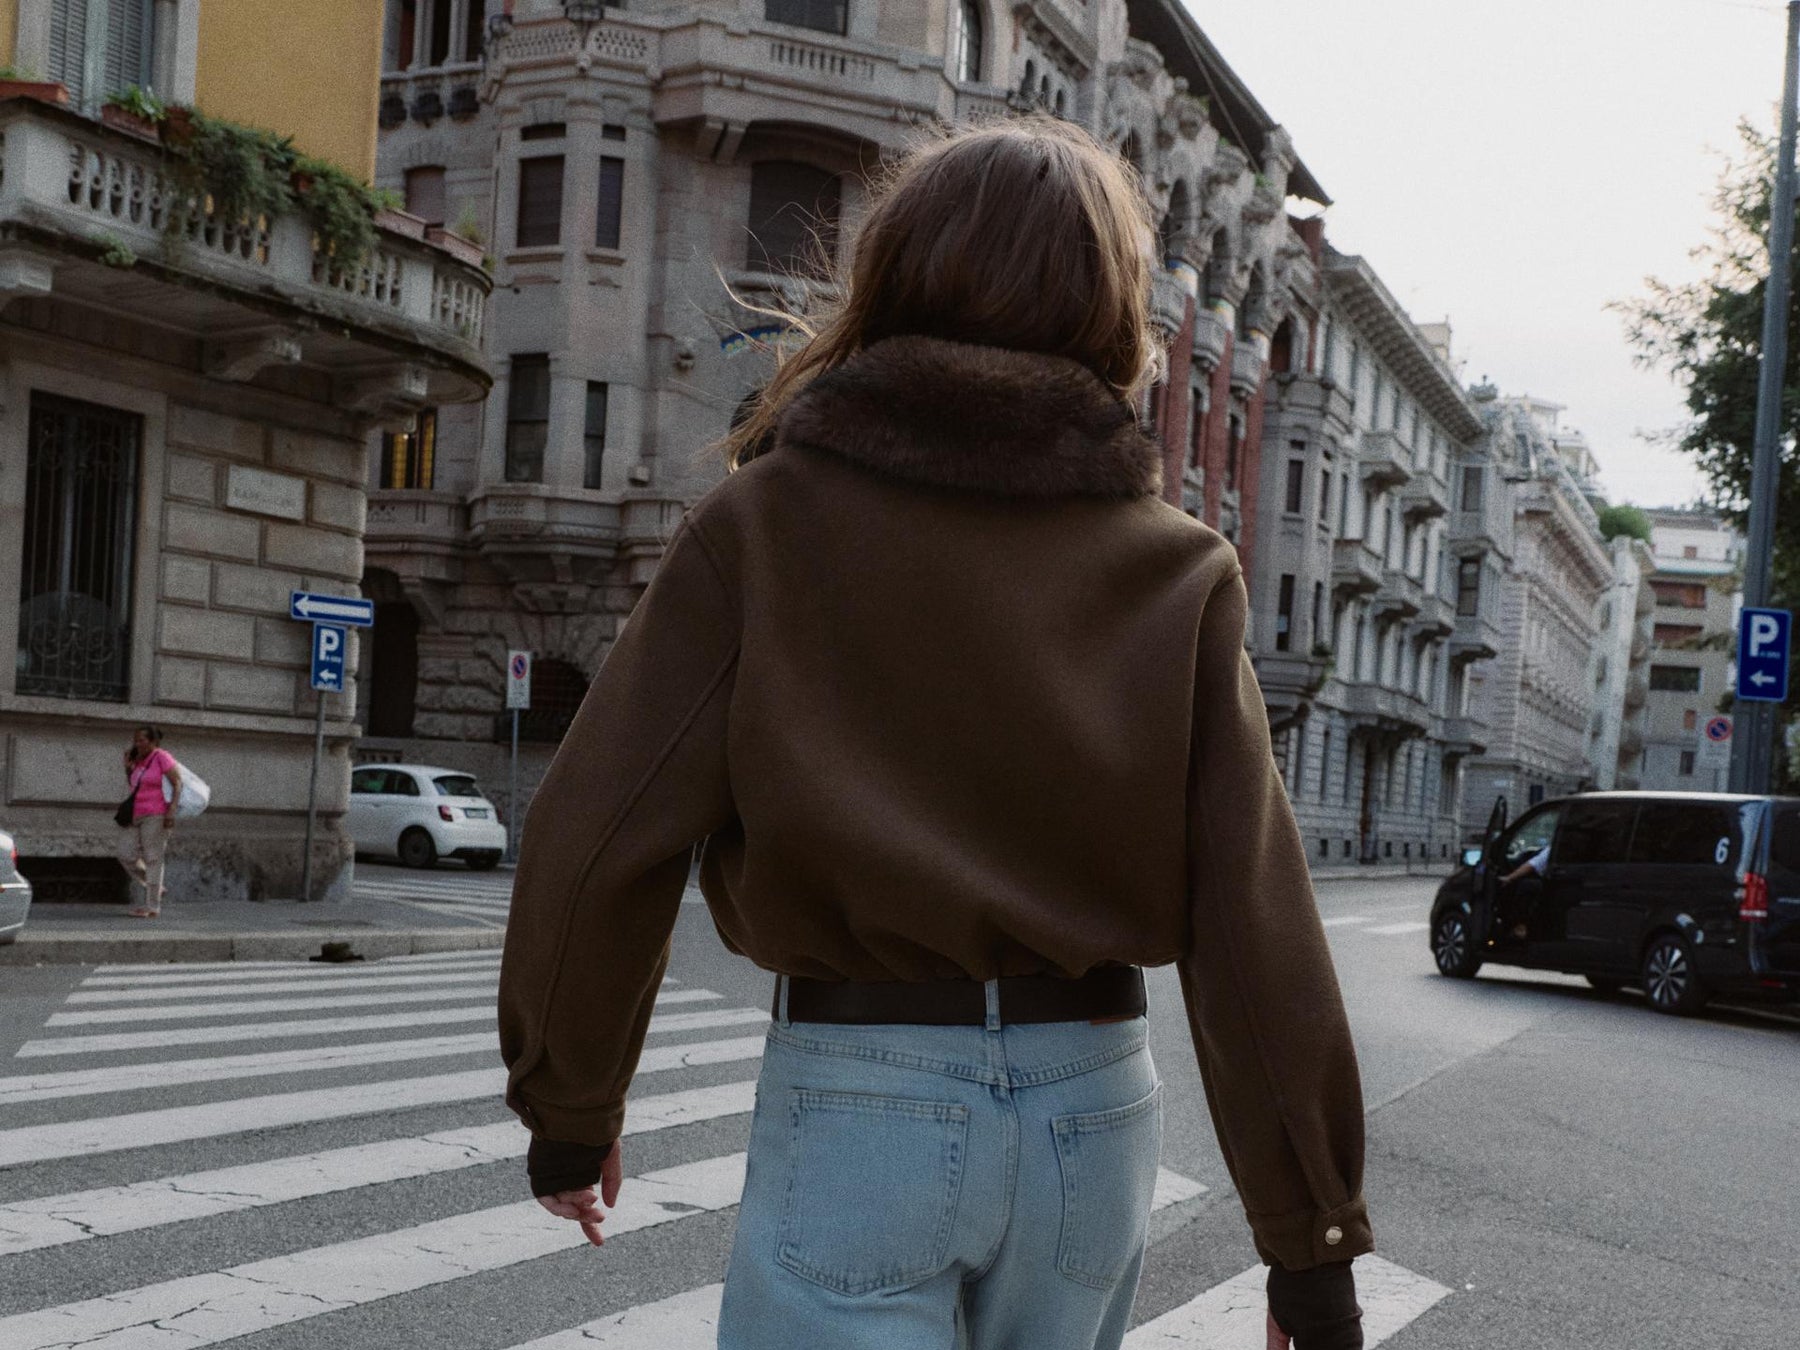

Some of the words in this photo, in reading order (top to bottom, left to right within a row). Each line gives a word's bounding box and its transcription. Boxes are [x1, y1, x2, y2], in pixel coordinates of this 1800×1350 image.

[319, 628, 340, 661] P
[1749, 614, 1780, 657] P
[1714, 836, 1730, 864] 6
